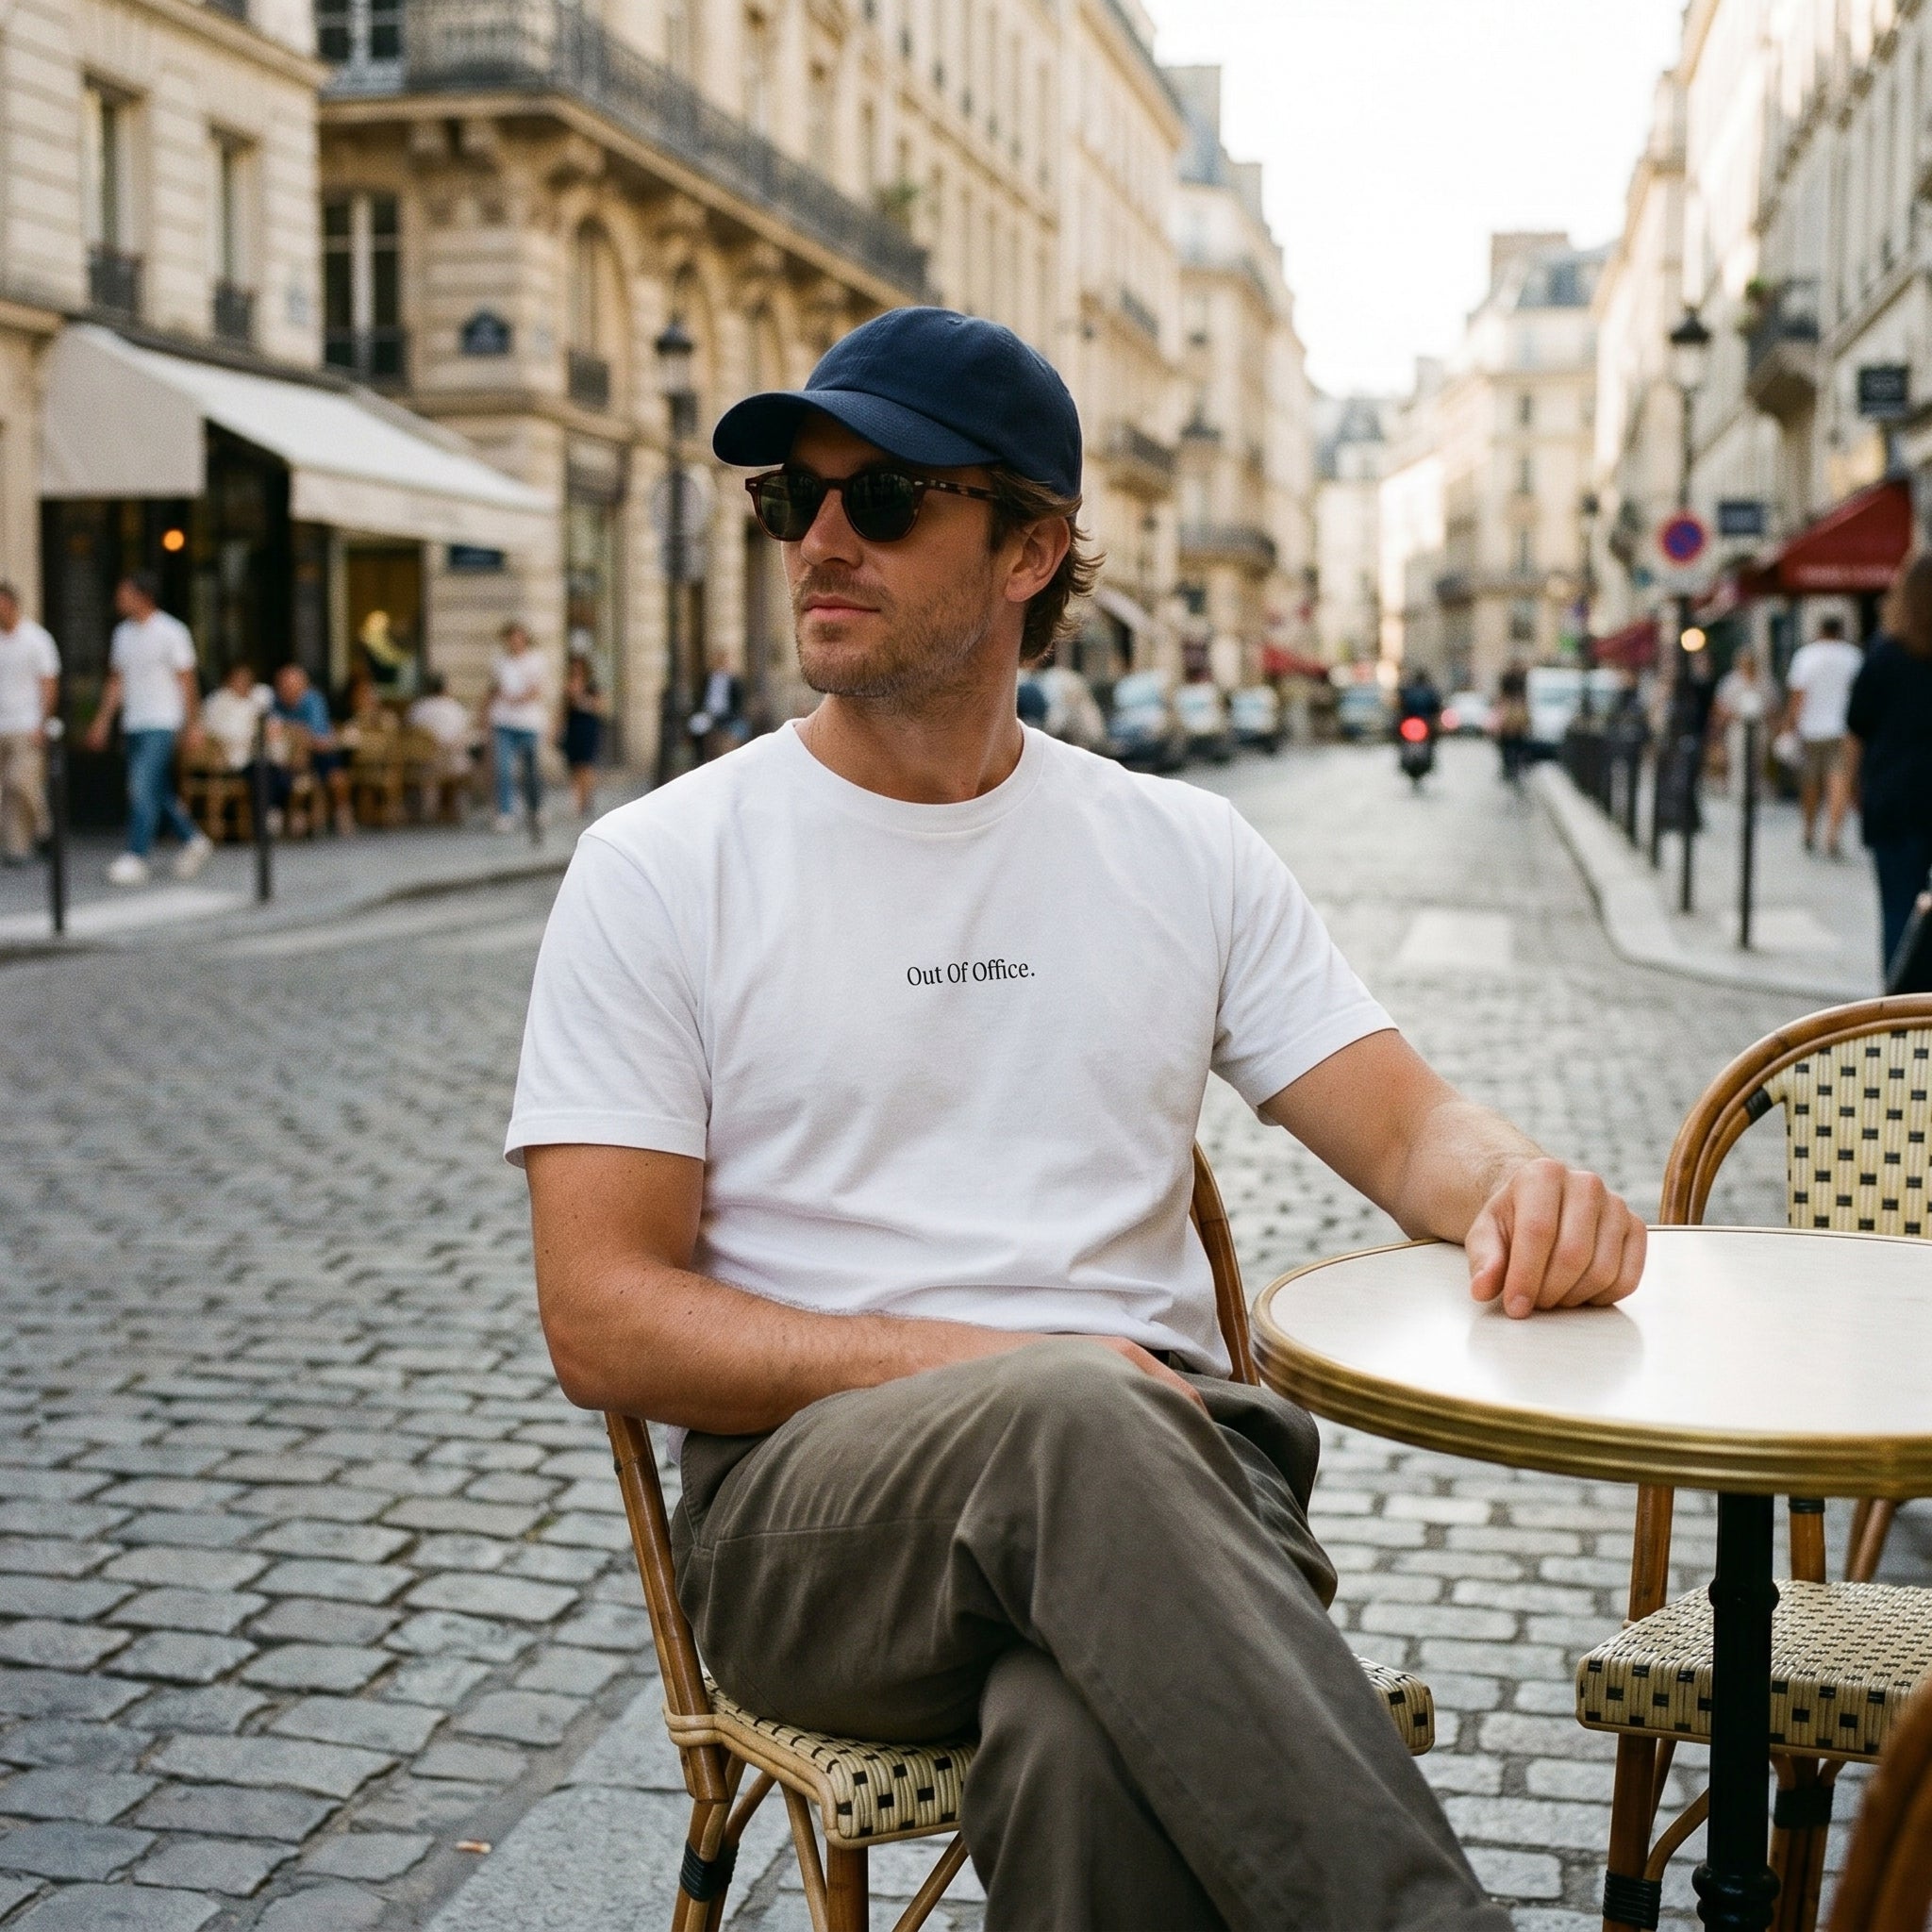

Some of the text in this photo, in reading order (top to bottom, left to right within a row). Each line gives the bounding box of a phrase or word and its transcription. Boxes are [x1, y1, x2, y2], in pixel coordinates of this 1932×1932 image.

[907, 958, 1036, 986] Out Of Office.
